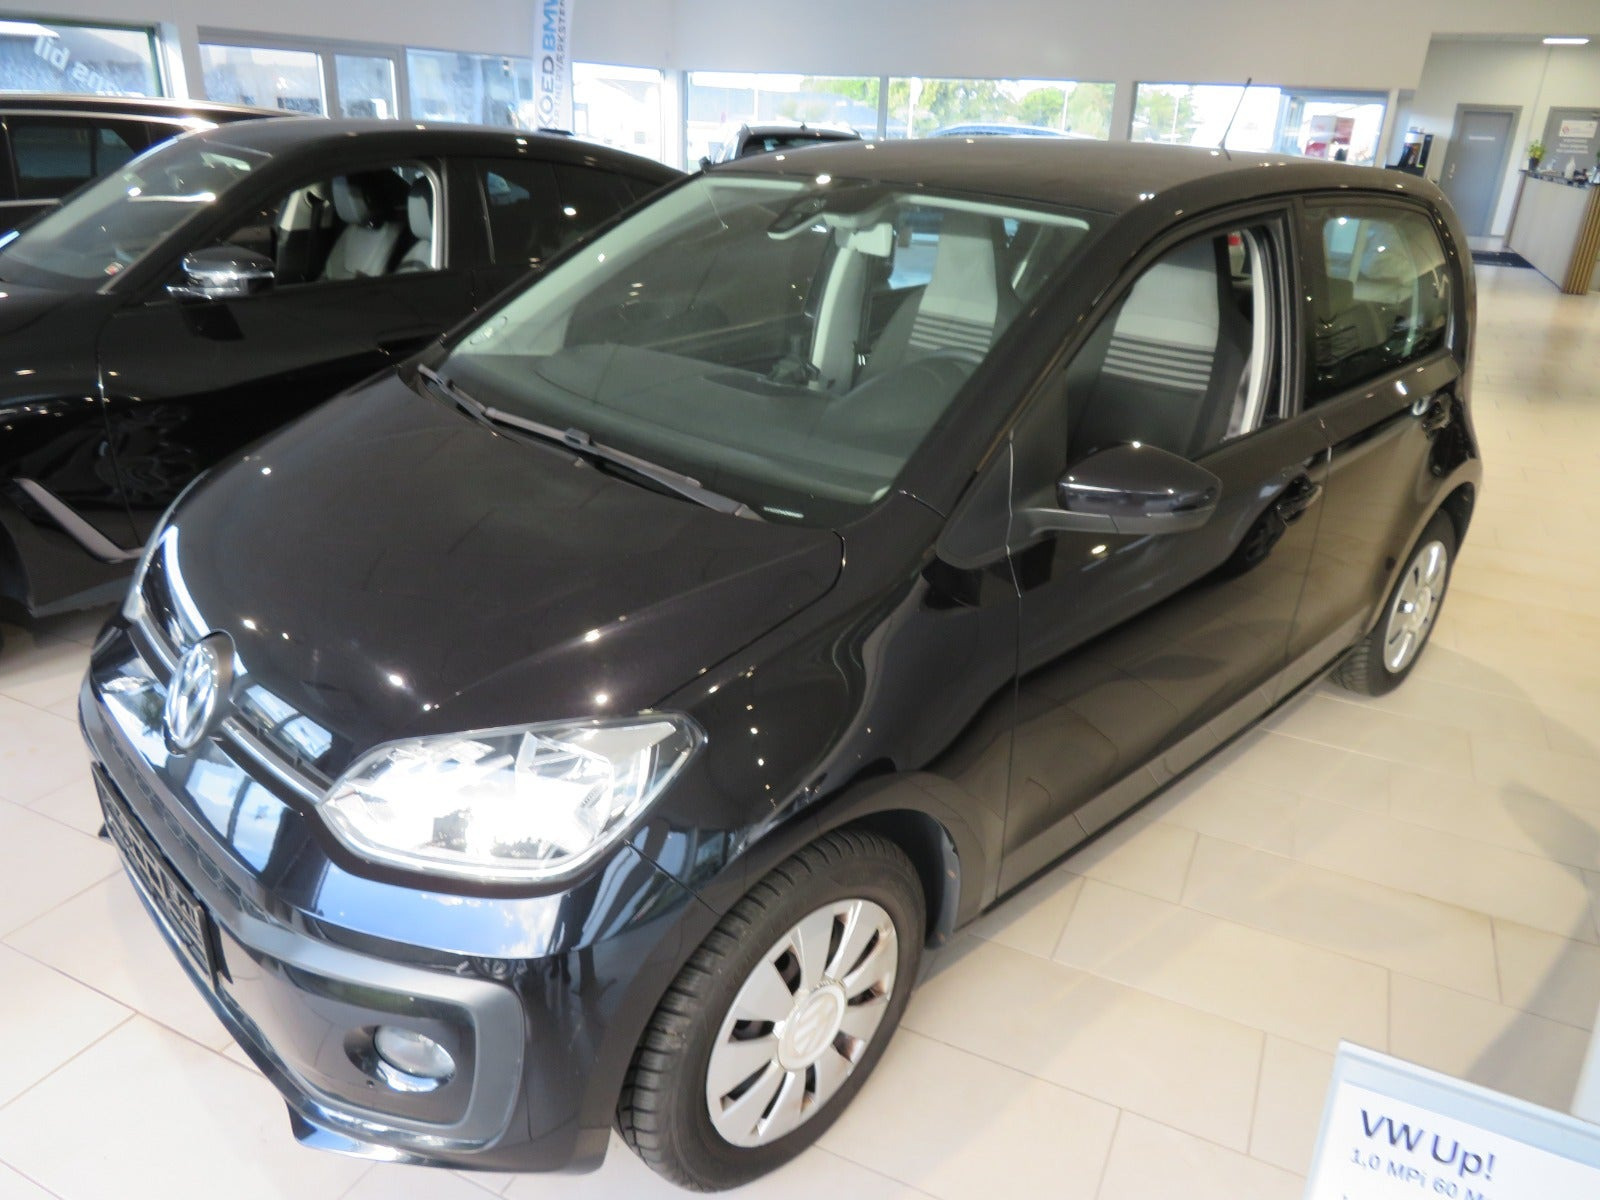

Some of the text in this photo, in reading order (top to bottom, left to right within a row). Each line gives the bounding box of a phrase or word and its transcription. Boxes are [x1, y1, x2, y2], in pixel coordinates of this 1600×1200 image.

[542, 0, 559, 51] BM
[1360, 1107, 1496, 1181] VW Up!
[1351, 1148, 1381, 1170] 1.0
[1432, 1177, 1458, 1199] 60
